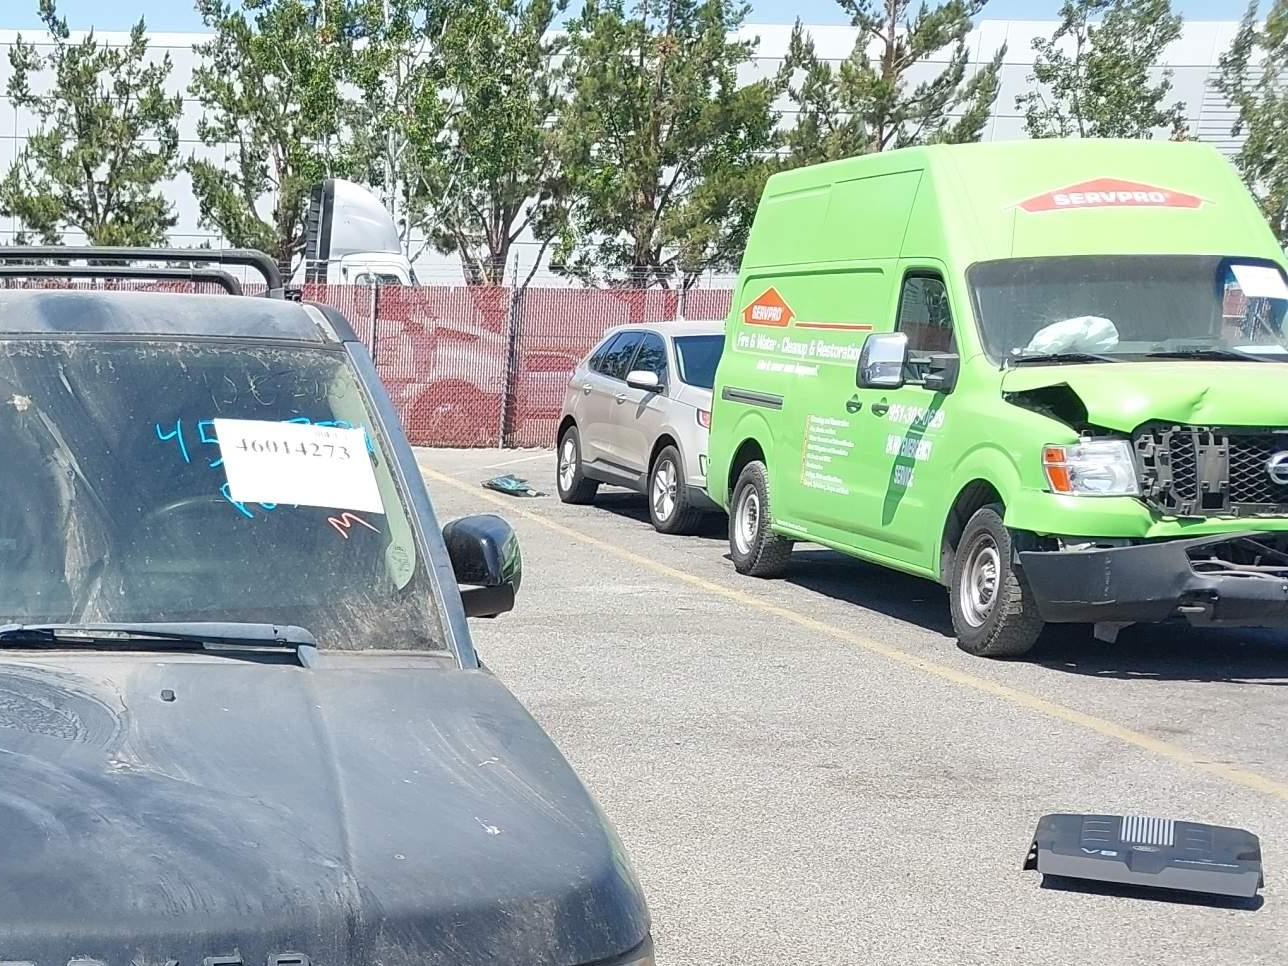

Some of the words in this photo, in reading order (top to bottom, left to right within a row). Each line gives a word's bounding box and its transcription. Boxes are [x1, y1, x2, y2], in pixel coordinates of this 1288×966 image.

[1053, 191, 1166, 206] SERVPRO
[752, 305, 782, 321] SERVPRO
[737, 331, 750, 348] Fire
[756, 333, 777, 351] Water
[781, 336, 808, 358] Cleanup
[815, 340, 860, 360] Restoratio
[236, 438, 351, 461] 46014273
